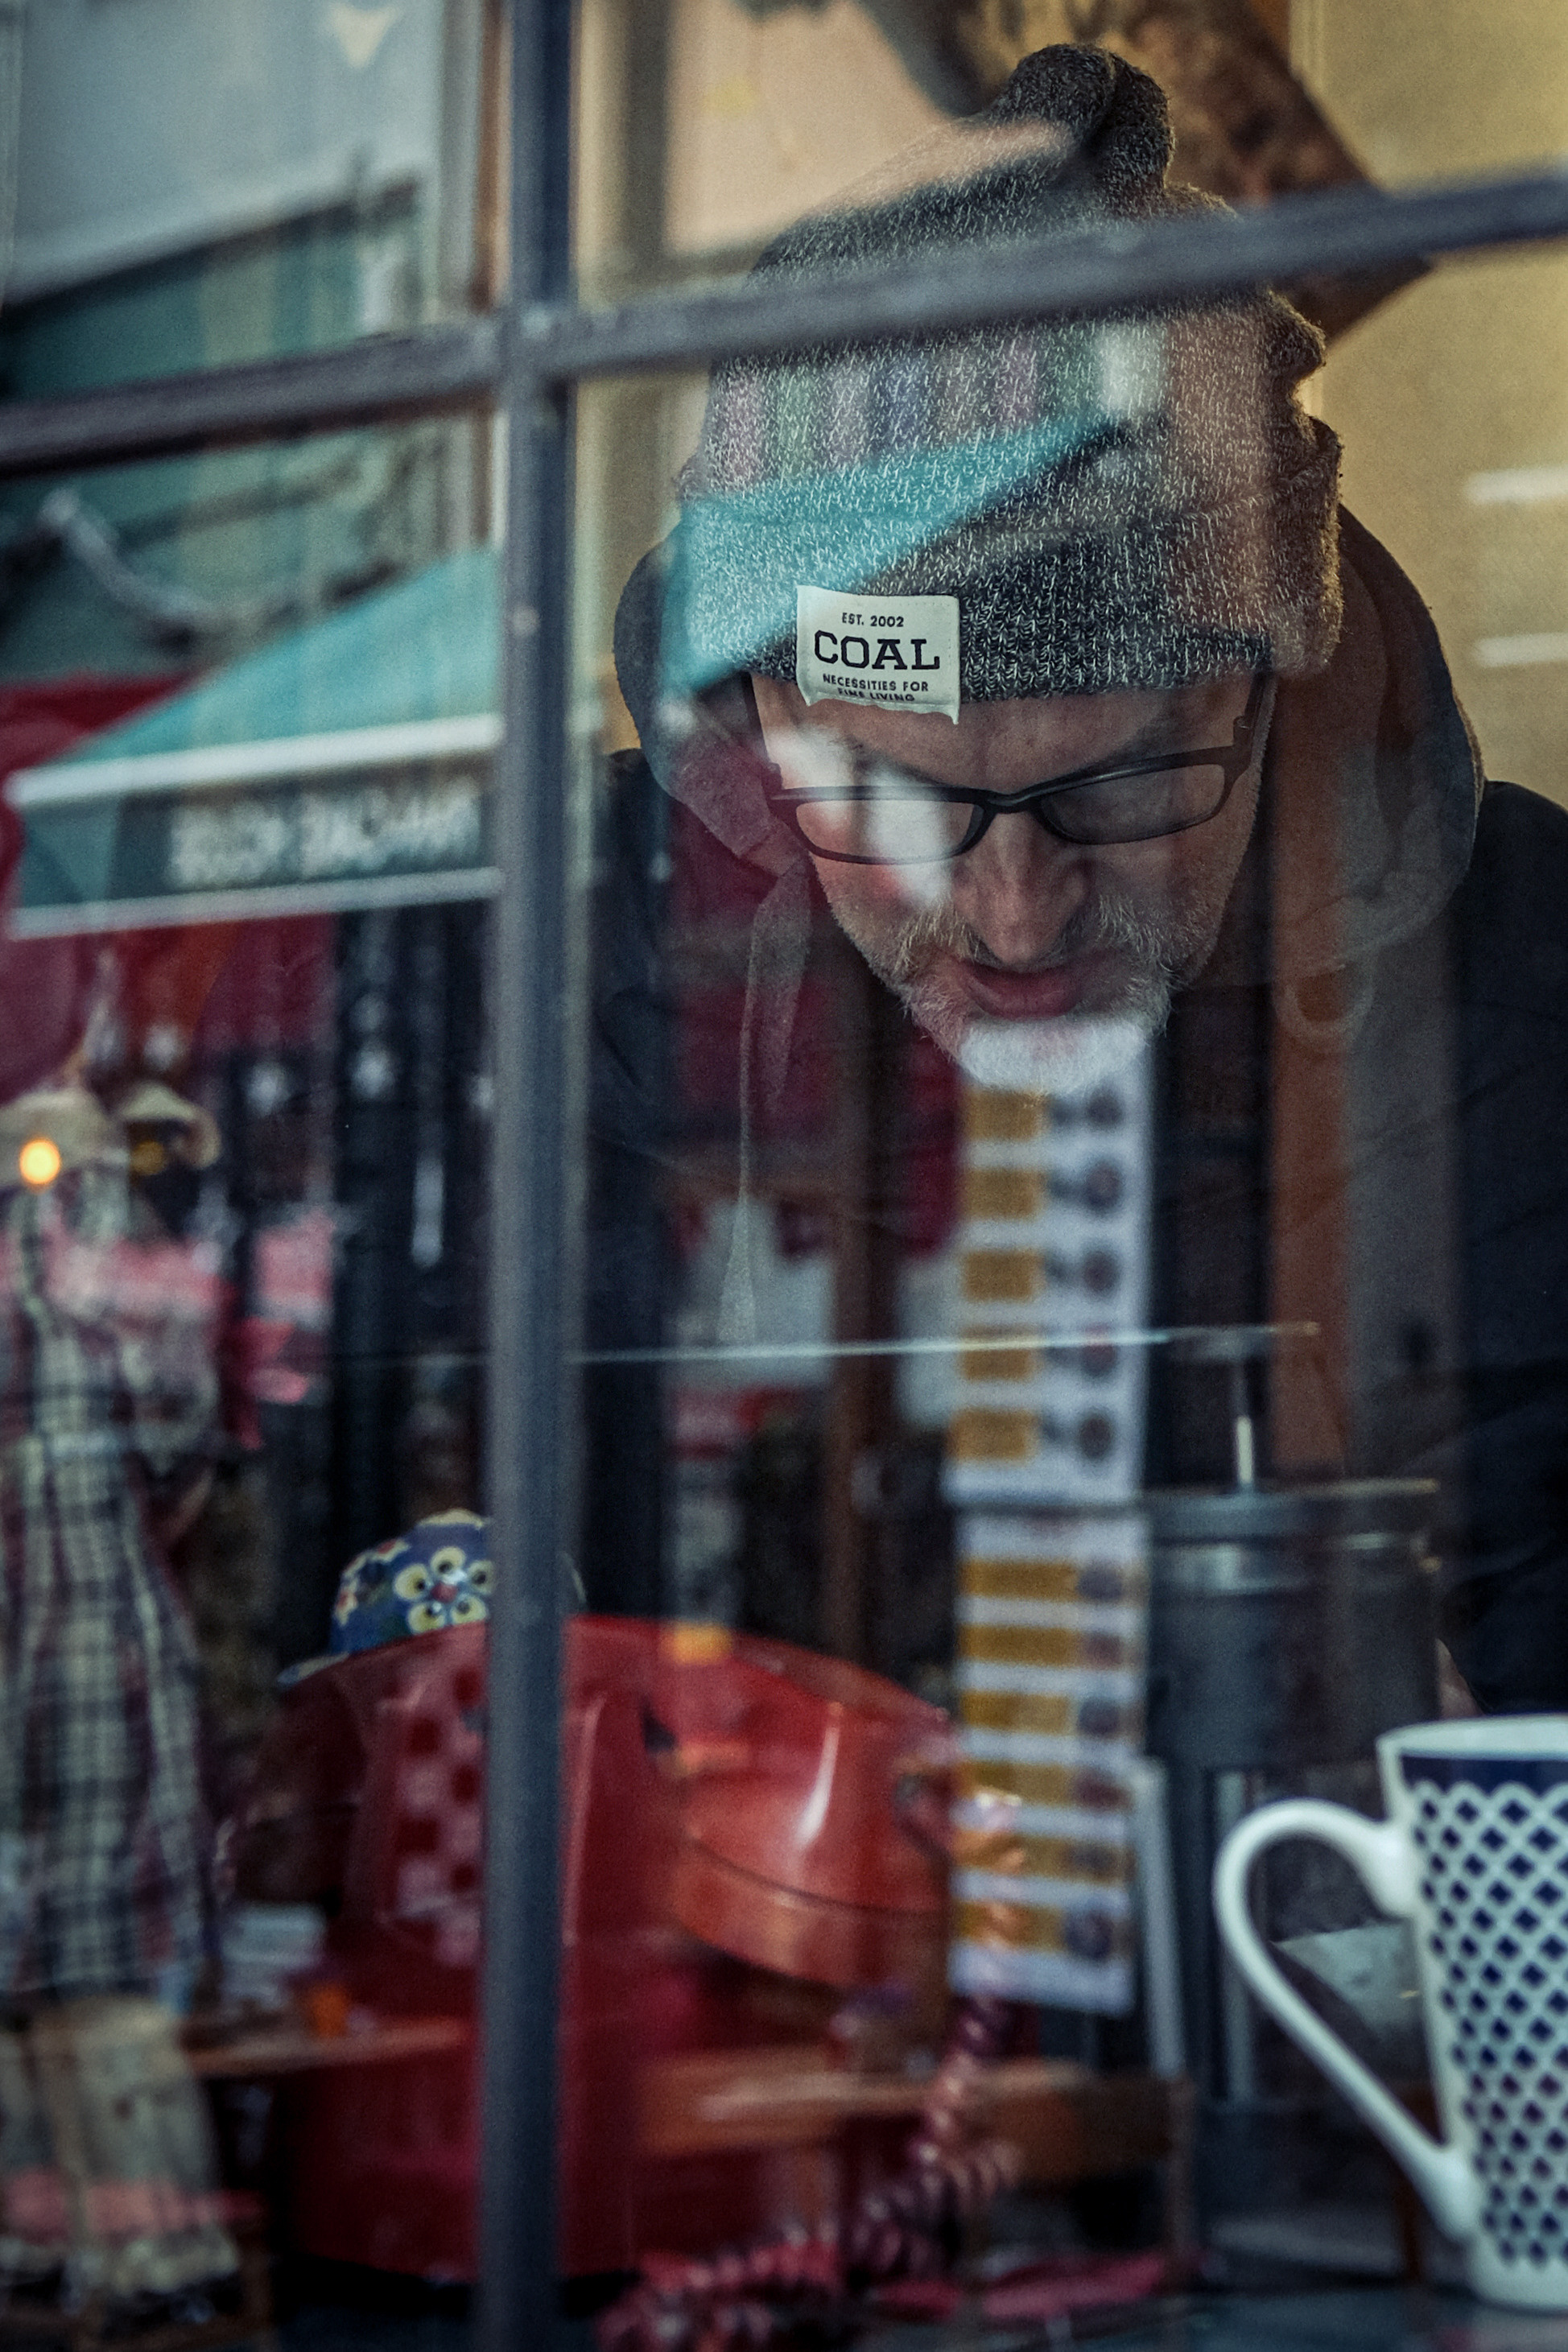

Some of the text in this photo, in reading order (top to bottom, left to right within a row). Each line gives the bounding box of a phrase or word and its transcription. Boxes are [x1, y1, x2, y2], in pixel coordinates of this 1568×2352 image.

[842, 612, 904, 628] EST. 2002
[814, 629, 940, 670] COAL
[823, 673, 929, 692] NECESSITIES FOR
[869, 692, 915, 702] LIVING
